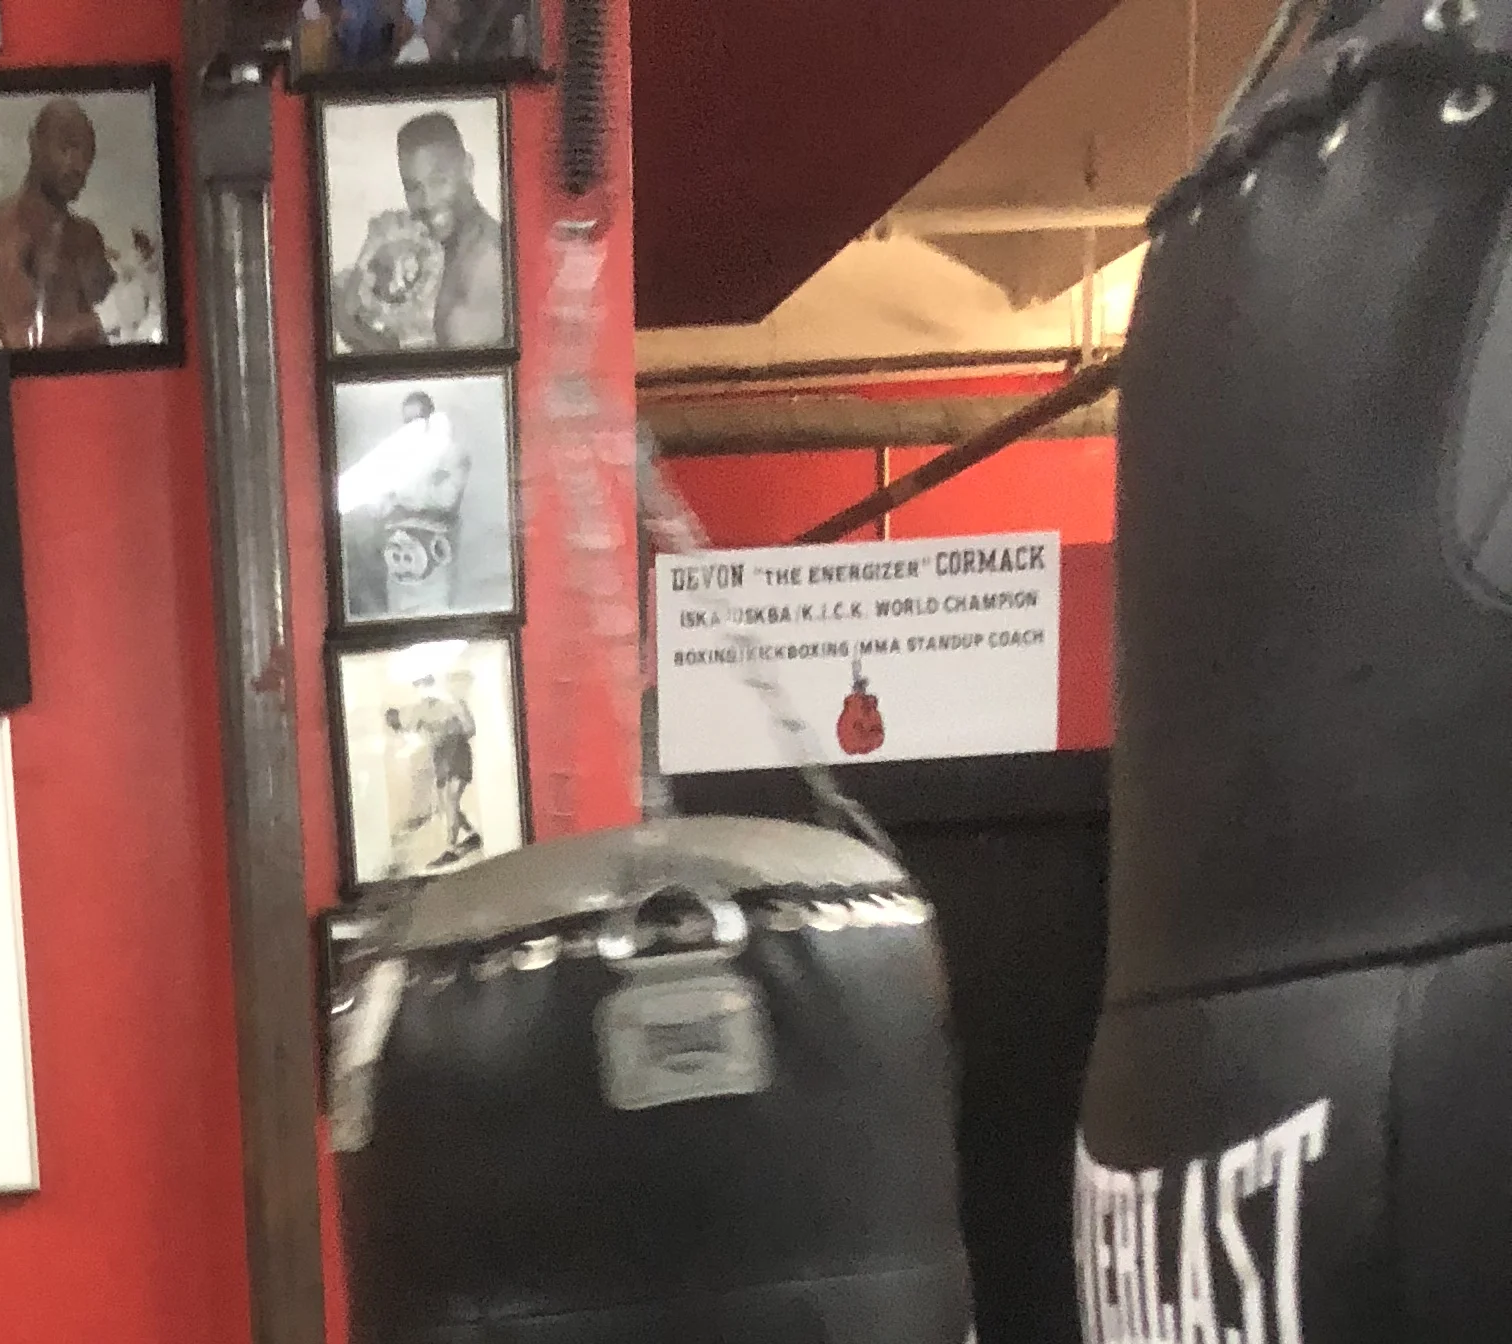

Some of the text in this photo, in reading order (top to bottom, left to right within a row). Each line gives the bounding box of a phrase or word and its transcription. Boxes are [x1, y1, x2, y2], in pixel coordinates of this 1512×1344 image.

[671, 564, 744, 591] DEVON
[935, 544, 1045, 576] CORMACK
[875, 596, 938, 617] WORLD
[942, 589, 1038, 613] CHAMPION
[906, 632, 984, 652] STANDUP
[988, 628, 1044, 649] COACH
